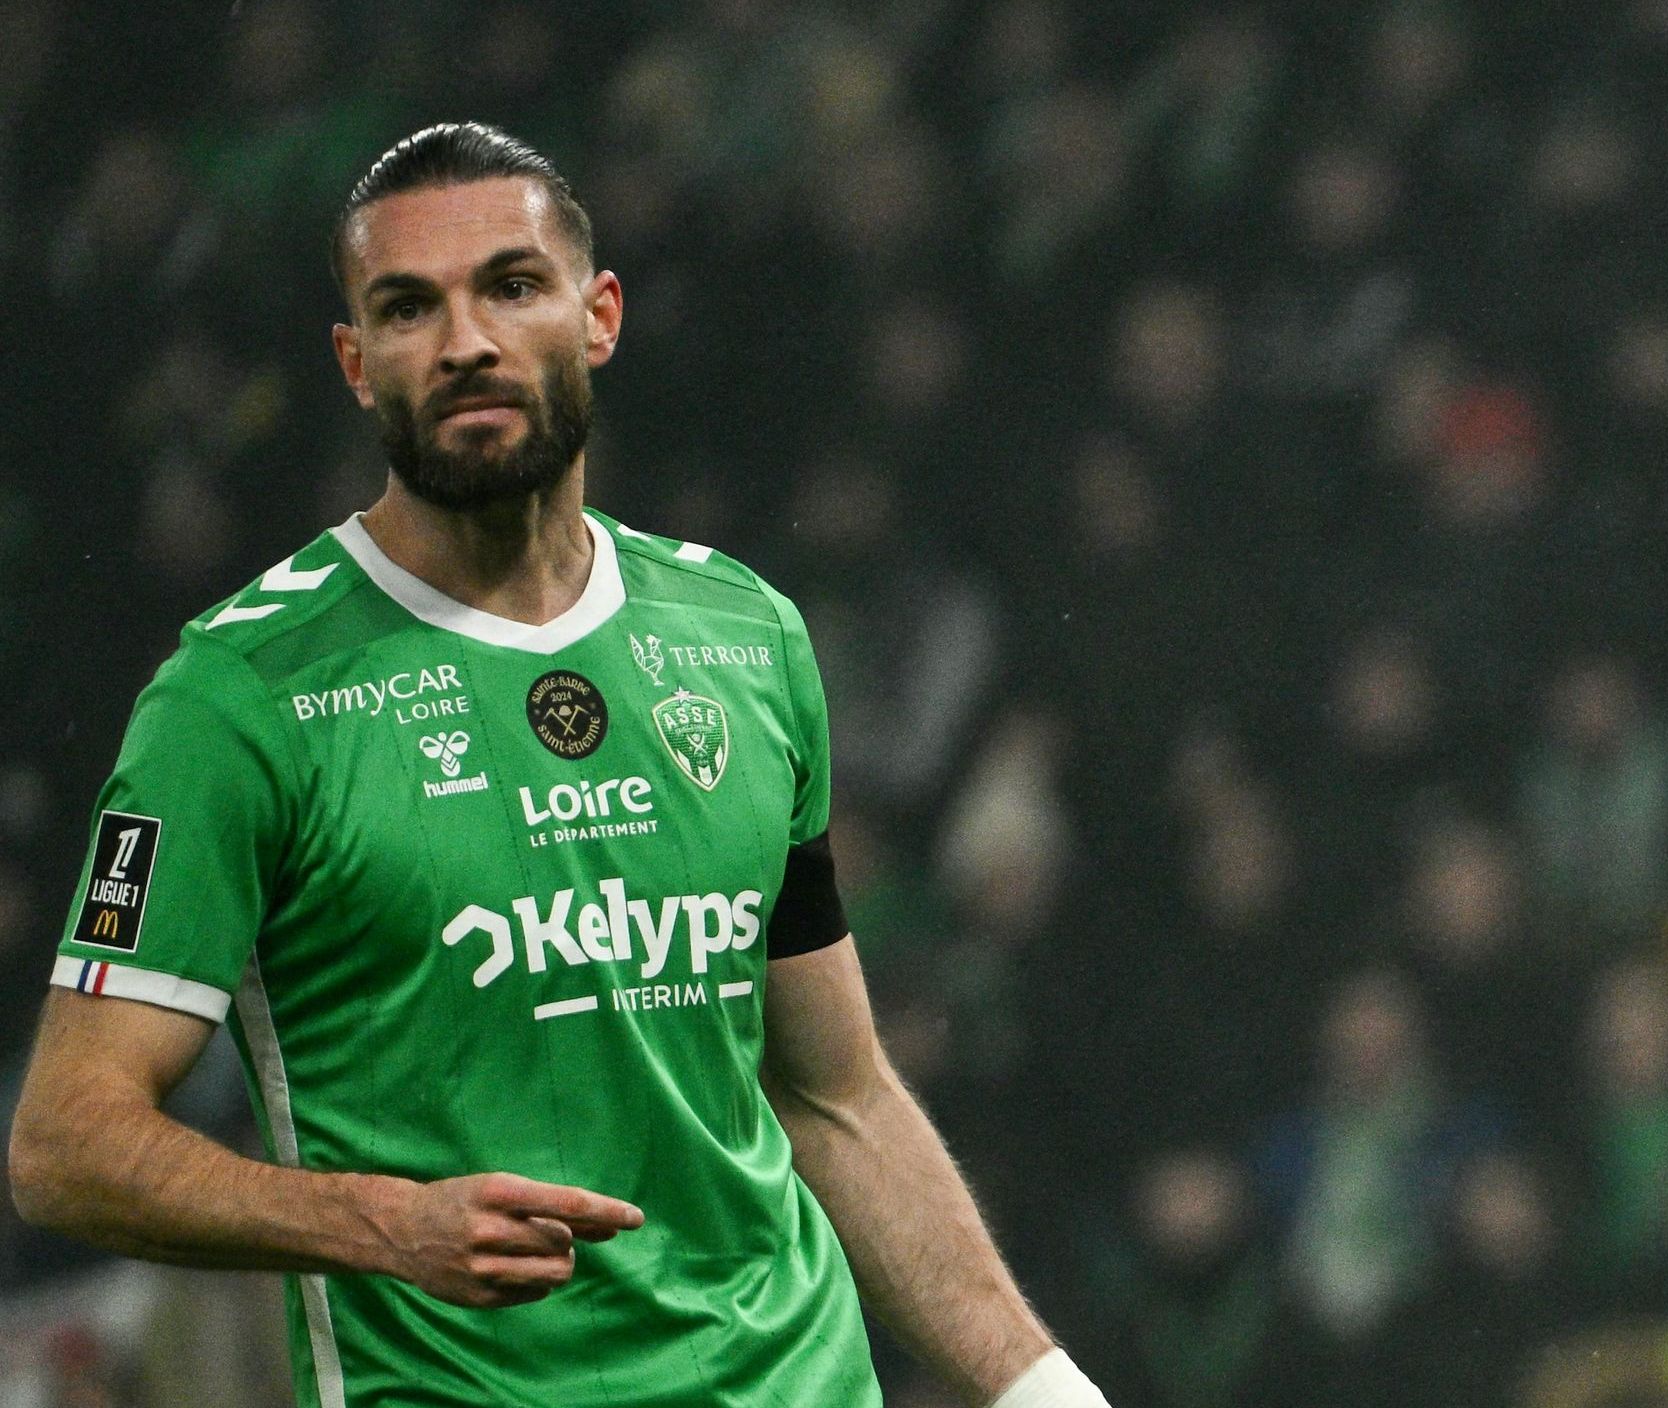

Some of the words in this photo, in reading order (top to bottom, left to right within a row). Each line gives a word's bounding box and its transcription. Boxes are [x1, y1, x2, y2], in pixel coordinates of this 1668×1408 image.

[668, 645, 773, 667] TERROIR
[396, 695, 470, 725] LOIRE
[550, 690, 572, 702] 2024
[662, 705, 718, 730] ASSE
[422, 771, 489, 799] hummel
[518, 775, 654, 827] Loire
[530, 832, 548, 848] LE
[91, 878, 132, 907] LIGUE
[511, 877, 764, 979] Kelyps
